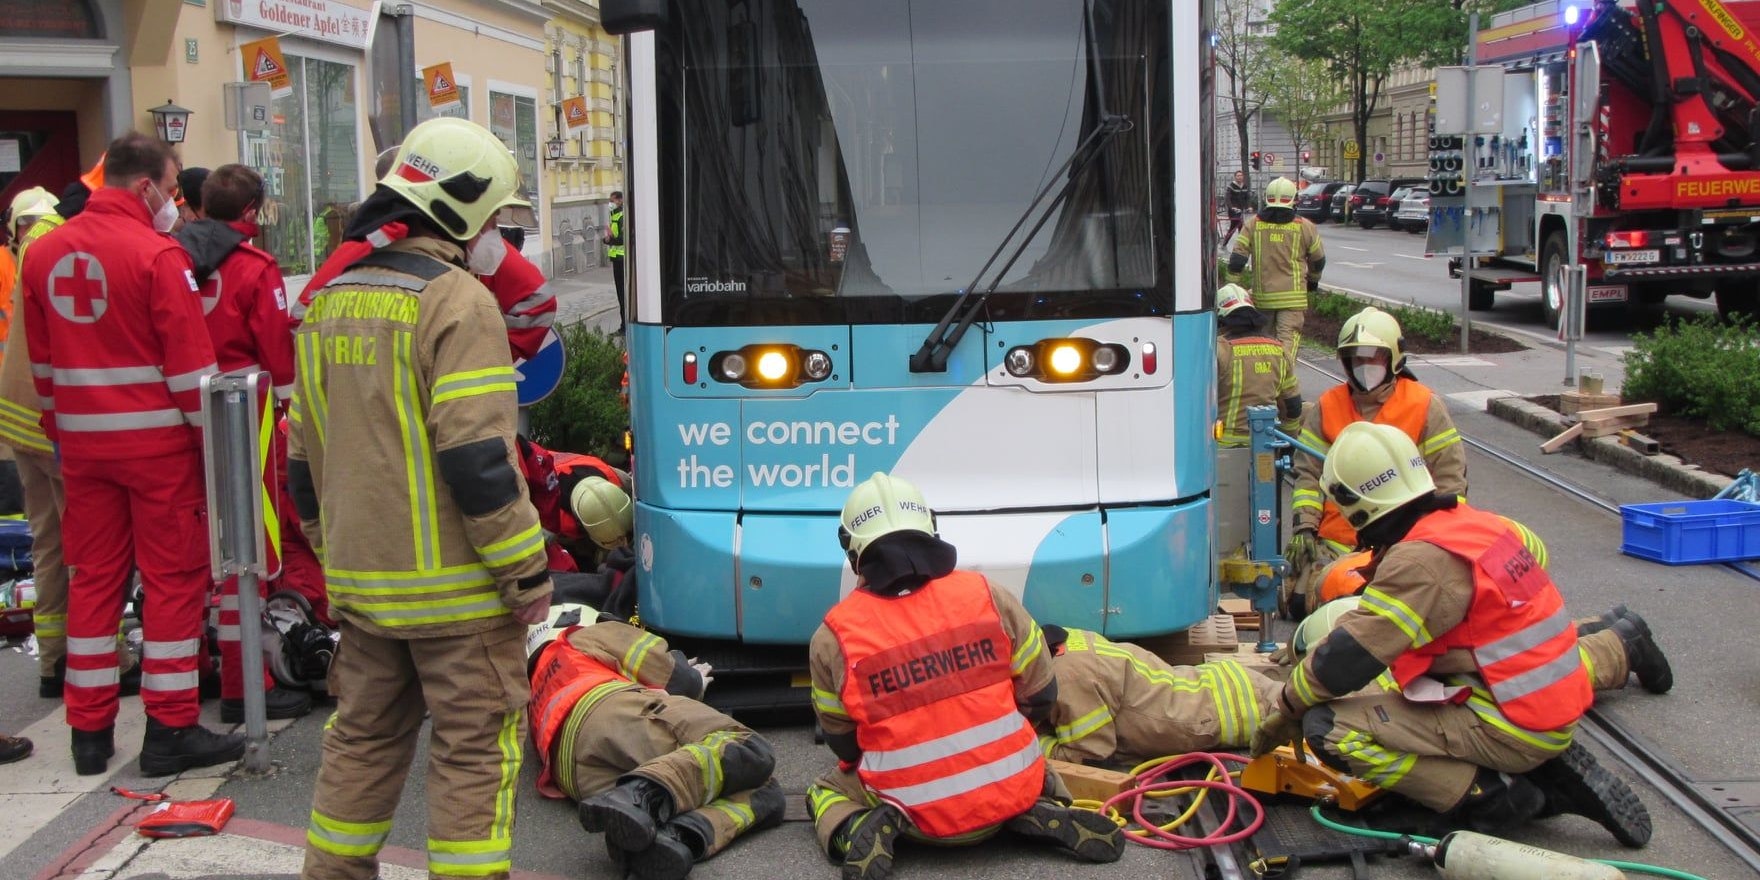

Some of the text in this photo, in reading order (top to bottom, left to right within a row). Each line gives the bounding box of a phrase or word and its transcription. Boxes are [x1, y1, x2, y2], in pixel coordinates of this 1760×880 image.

[259, 1, 340, 37] Goldener Apfel
[406, 152, 440, 178] WEHR
[687, 279, 747, 293] variobahn
[1591, 289, 1623, 299] EMPL
[324, 335, 377, 365] GRAZ
[1254, 361, 1272, 374] GRAZ
[678, 415, 900, 446] we connect
[677, 454, 855, 488] the world
[1360, 468, 1397, 495] FEUER
[851, 505, 882, 530] FEUER
[868, 638, 998, 698] FEUERWEHR
